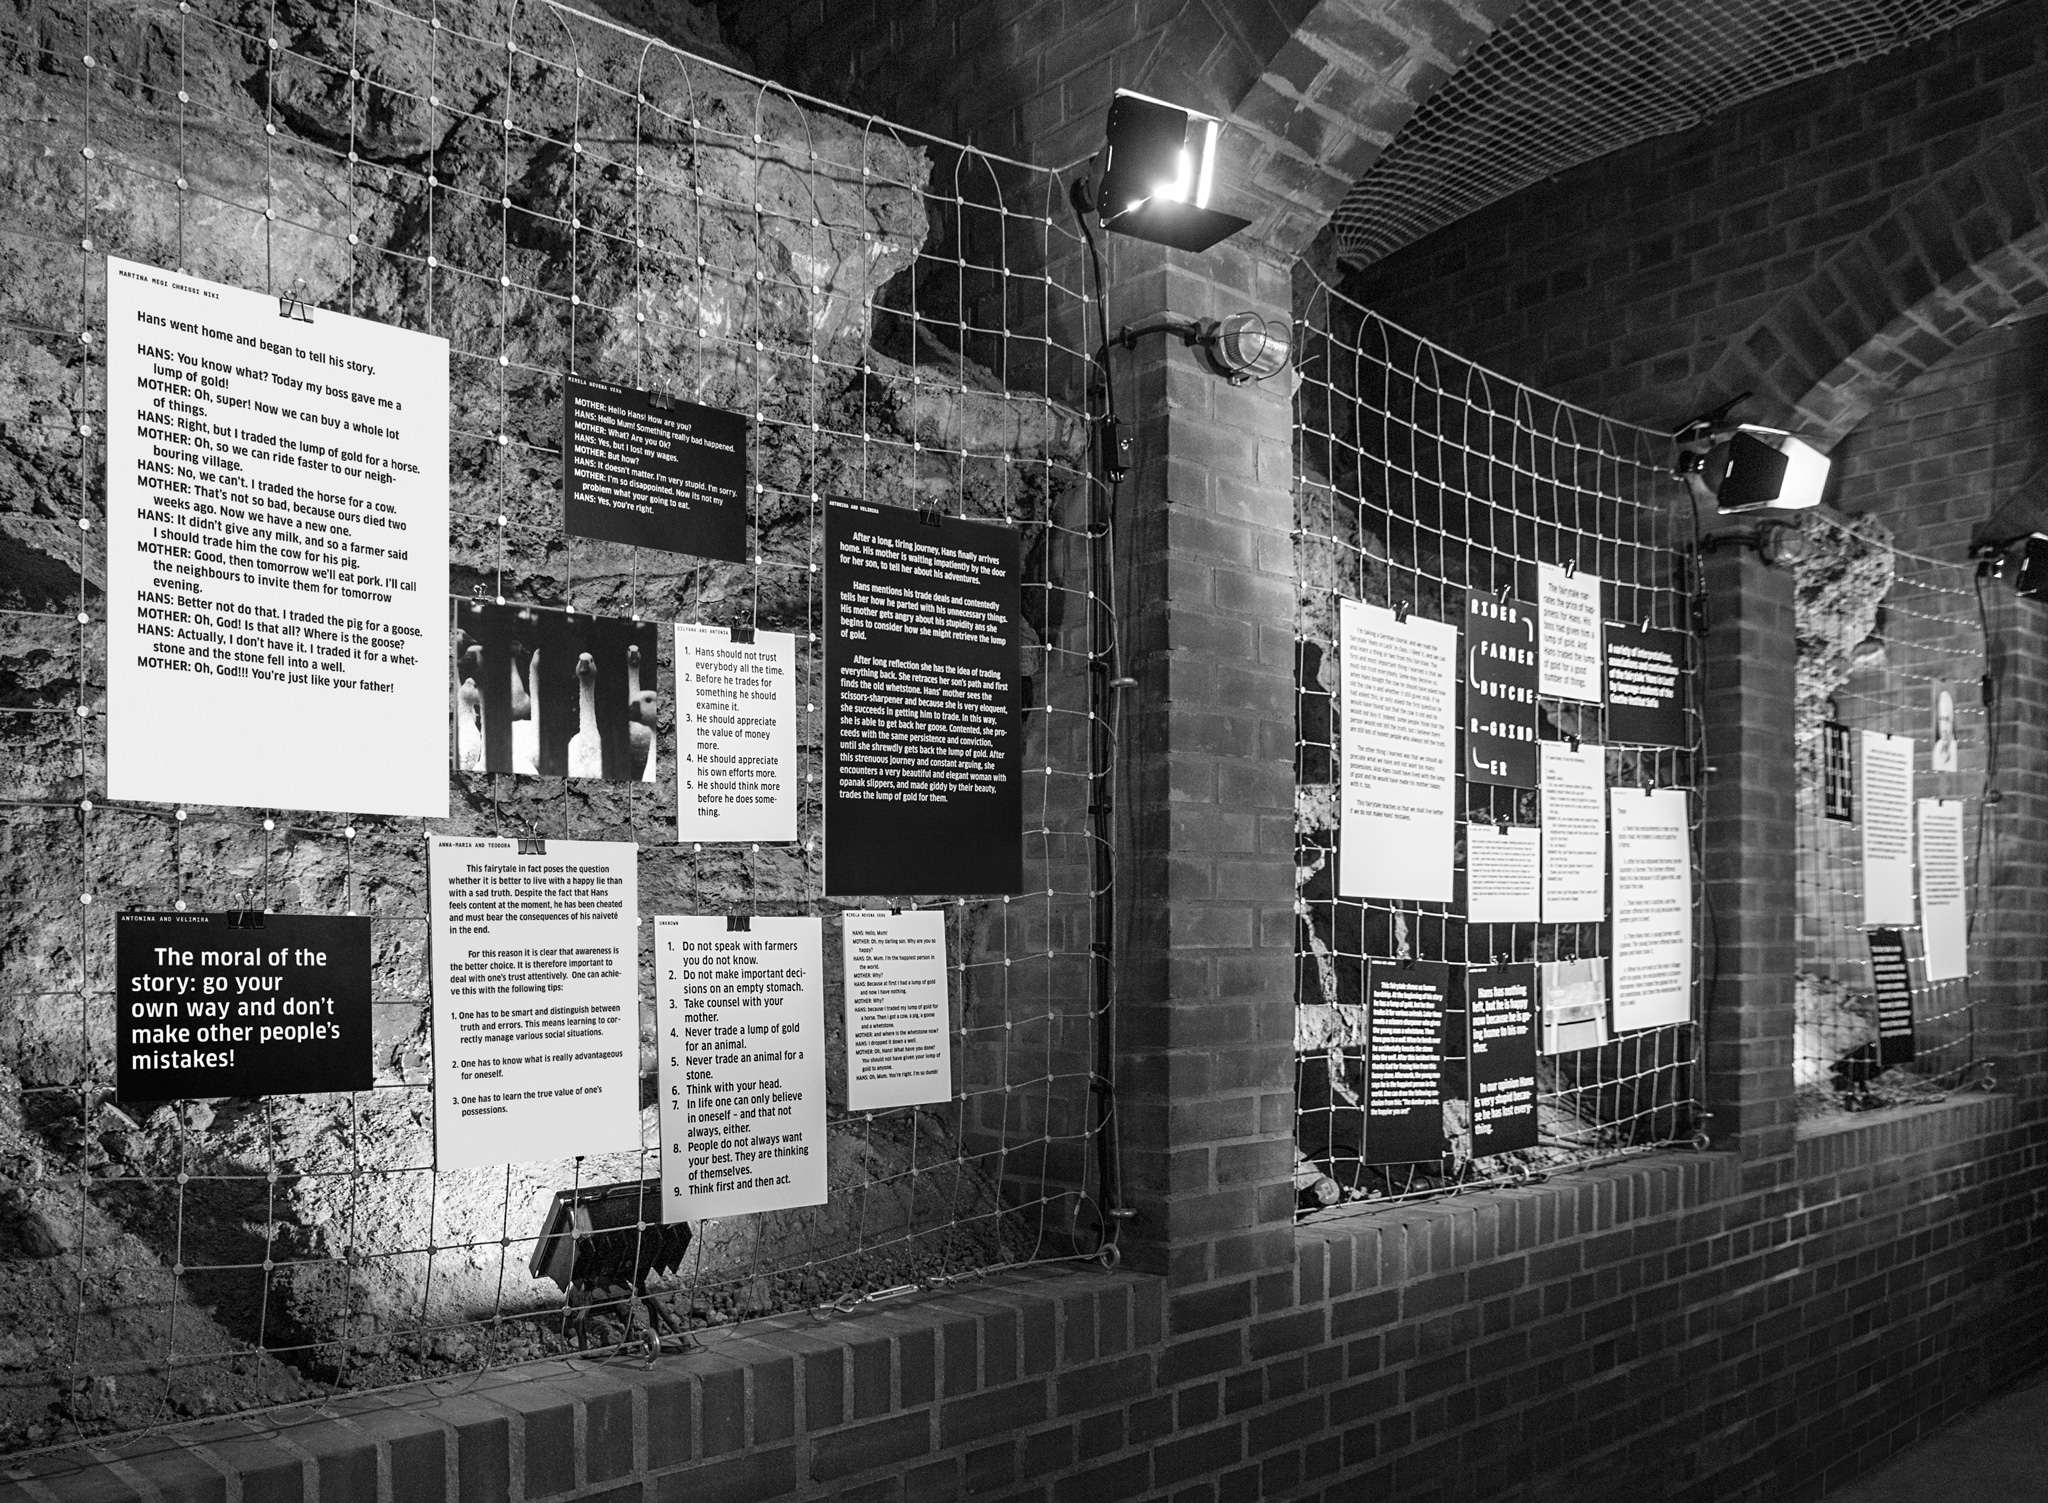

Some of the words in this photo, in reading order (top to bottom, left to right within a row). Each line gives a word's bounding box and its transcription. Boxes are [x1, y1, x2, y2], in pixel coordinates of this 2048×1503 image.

[118, 270, 148, 282] MARTINA
[171, 283, 199, 294] CHRISSI
[203, 290, 219, 299] NIKI
[137, 310, 166, 327] Hans
[169, 319, 198, 335] went
[201, 325, 233, 342] home
[236, 335, 256, 348] and
[259, 338, 292, 356] began
[295, 347, 306, 359] to
[308, 350, 326, 363] tell
[329, 354, 344, 368] his
[346, 360, 375, 376] story.
[137, 343, 174, 361] HANS:
[177, 352, 198, 366] You
[201, 357, 232, 374] know
[235, 366, 268, 382] what?
[271, 372, 303, 391] Today
[306, 382, 322, 395] my
[325, 384, 348, 399] boss
[351, 392, 375, 405] gave
[378, 398, 393, 409] me
[396, 402, 401, 411] a
[153, 362, 182, 380] lump
[185, 371, 198, 382] of
[201, 375, 228, 389] gold!
[574, 397, 607, 412] MOTHER:
[608, 404, 626, 416] Hello
[627, 409, 646, 420] Hans!
[647, 414, 662, 424] How
[663, 419, 675, 428] are
[676, 422, 692, 431] you?
[574, 408, 596, 421] HANS:
[597, 414, 616, 425] Hello
[616, 418, 635, 430] Mum!
[636, 423, 671, 439] Something
[671, 432, 690, 443] really
[690, 435, 703, 445] bad
[703, 438, 735, 452] happened.
[574, 420, 606, 435] MOTHER:
[608, 428, 630, 440] What?
[630, 433, 643, 443] Are
[644, 437, 657, 446] you
[658, 439, 671, 449] Ok?
[852, 531, 871, 542] After
[871, 536, 876, 544] a
[877, 535, 894, 548] long,
[894, 538, 913, 552] tiring
[913, 541, 940, 556] journey,
[941, 546, 957, 558] Hans
[957, 549, 977, 562] finally
[978, 554, 1000, 565] arrives
[1471, 599, 1517, 623] RIDER
[684, 646, 690, 655] 1.
[695, 647, 715, 657] Hans
[716, 648, 742, 659] should
[744, 652, 757, 660] not
[758, 652, 777, 662] trust
[137, 655, 191, 672] MOTHER:
[194, 662, 213, 675] Oh,
[216, 664, 248, 678] God!!!
[251, 668, 285, 682] You're
[287, 671, 308, 684] just
[311, 674, 330, 686] like
[332, 678, 357, 689] your
[359, 679, 394, 693] father!
[695, 661, 738, 673] everybody
[739, 663, 749, 672] all
[751, 664, 764, 674] the
[765, 665, 784, 675] time.
[685, 672, 692, 682] 2.
[695, 673, 722, 684] Before
[723, 675, 733, 685] he
[735, 676, 759, 686] trades
[760, 678, 772, 687] for
[1480, 680, 1533, 704] BUTCHE
[1471, 718, 1533, 742] R-GRIND
[1491, 760, 1507, 776] ER
[839, 789, 862, 799] trades
[862, 790, 875, 800] the
[875, 790, 893, 802] lump
[894, 791, 902, 800] of
[902, 792, 918, 802] gold
[918, 792, 928, 802] for
[929, 793, 948, 802] them.
[466, 864, 482, 872] This
[484, 864, 517, 874] fairytale
[518, 864, 526, 872] in
[527, 864, 542, 873] fact
[543, 866, 564, 874] poses
[565, 864, 578, 873] the
[578, 864, 610, 874] question
[667, 941, 674, 951] 1.
[682, 941, 695, 951] Do
[697, 941, 712, 951] not
[714, 940, 740, 952] speak
[742, 940, 762, 951] with
[764, 940, 798, 951] farmers
[155, 948, 193, 966] The
[201, 948, 261, 966] moral
[268, 948, 287, 966] of
[295, 949, 327, 966] the
[682, 956, 700, 967] you
[702, 954, 714, 965] do
[716, 955, 730, 965] not
[732, 954, 758, 965] know.
[668, 969, 677, 980] 2.
[683, 969, 696, 980] Do
[698, 969, 713, 980] not
[715, 969, 739, 979] make
[741, 968, 784, 980] important
[785, 967, 806, 978] deci-
[132, 974, 195, 995] story:
[203, 975, 228, 994] go
[235, 975, 282, 994] your
[132, 1001, 178, 1018] own
[187, 1001, 230, 1020] way
[238, 998, 275, 1016] and
[132, 1025, 190, 1043] make
[197, 1024, 253, 1042] other
[132, 1050, 235, 1069] mistakes!
